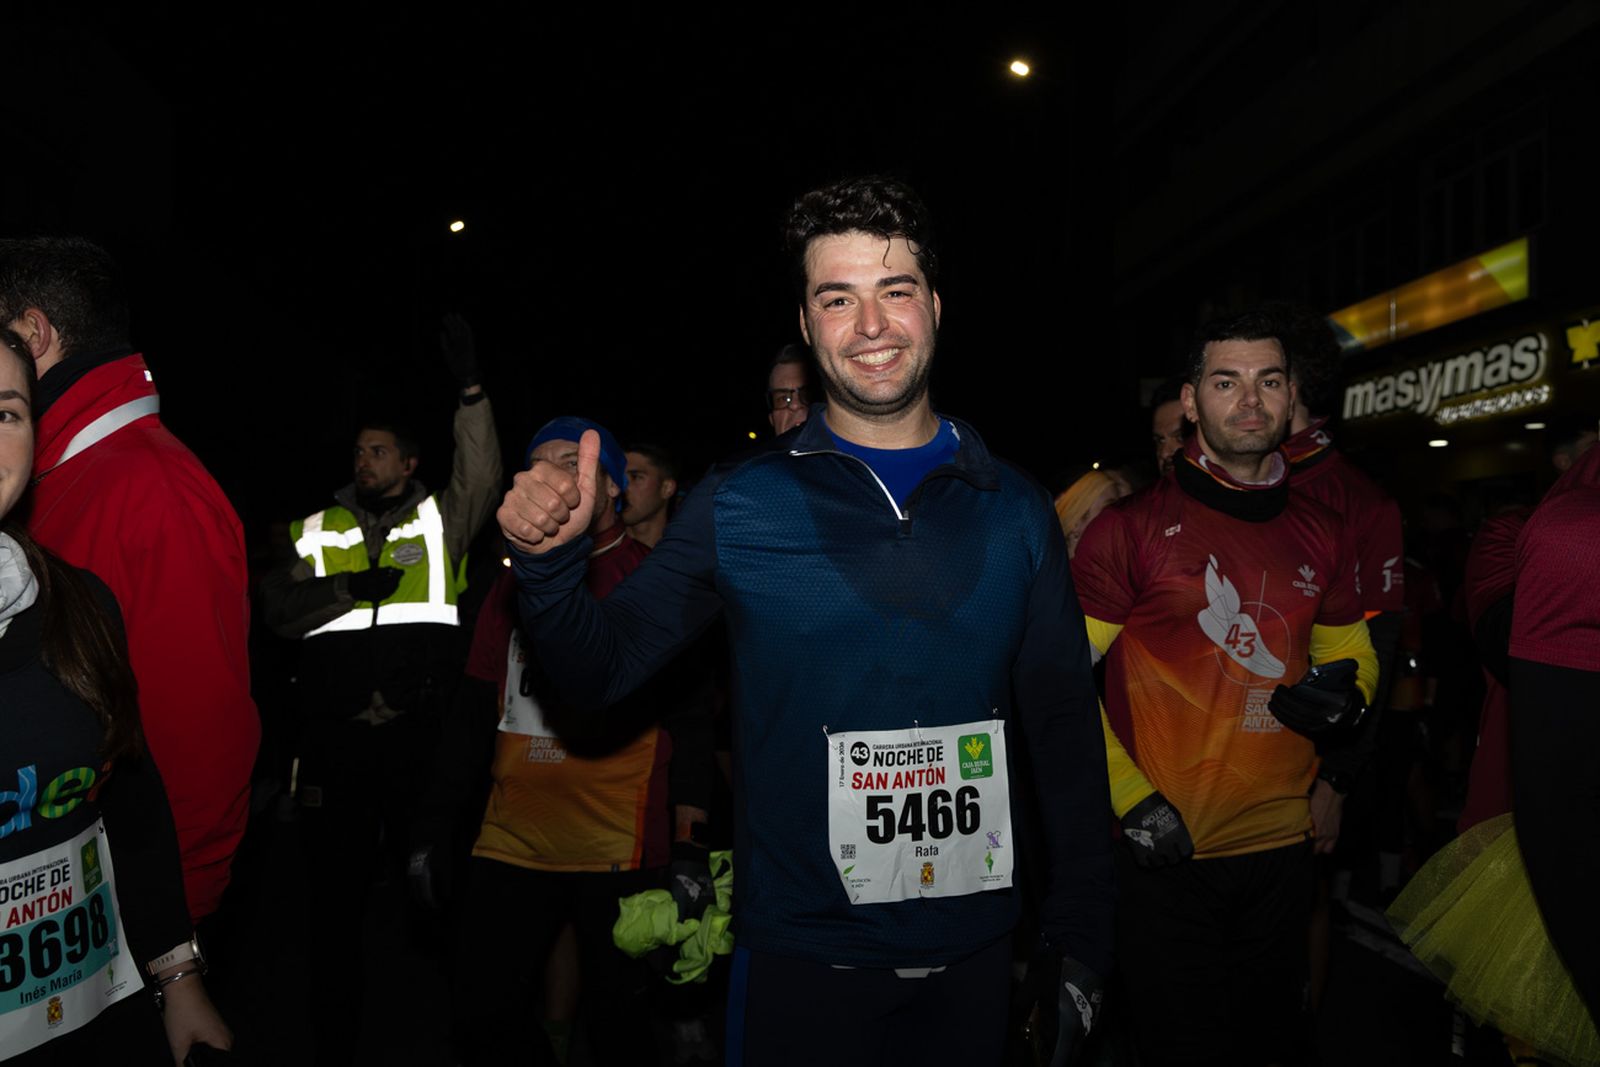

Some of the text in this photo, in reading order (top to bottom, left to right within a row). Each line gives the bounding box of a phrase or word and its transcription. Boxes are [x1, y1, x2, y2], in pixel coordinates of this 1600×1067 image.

[1343, 334, 1545, 421] masymas
[1225, 623, 1256, 658] 43
[851, 746, 869, 760] 43
[873, 745, 944, 767] NOCHE DE
[851, 763, 945, 790] SAN ANTÓN
[866, 785, 981, 844] 5466
[915, 845, 939, 858] Rafa
[51, 863, 70, 887] DE
[6, 885, 72, 929] ANTÓN
[0, 892, 109, 992] 3698
[20, 984, 46, 1005] Inés
[50, 968, 83, 993] María
